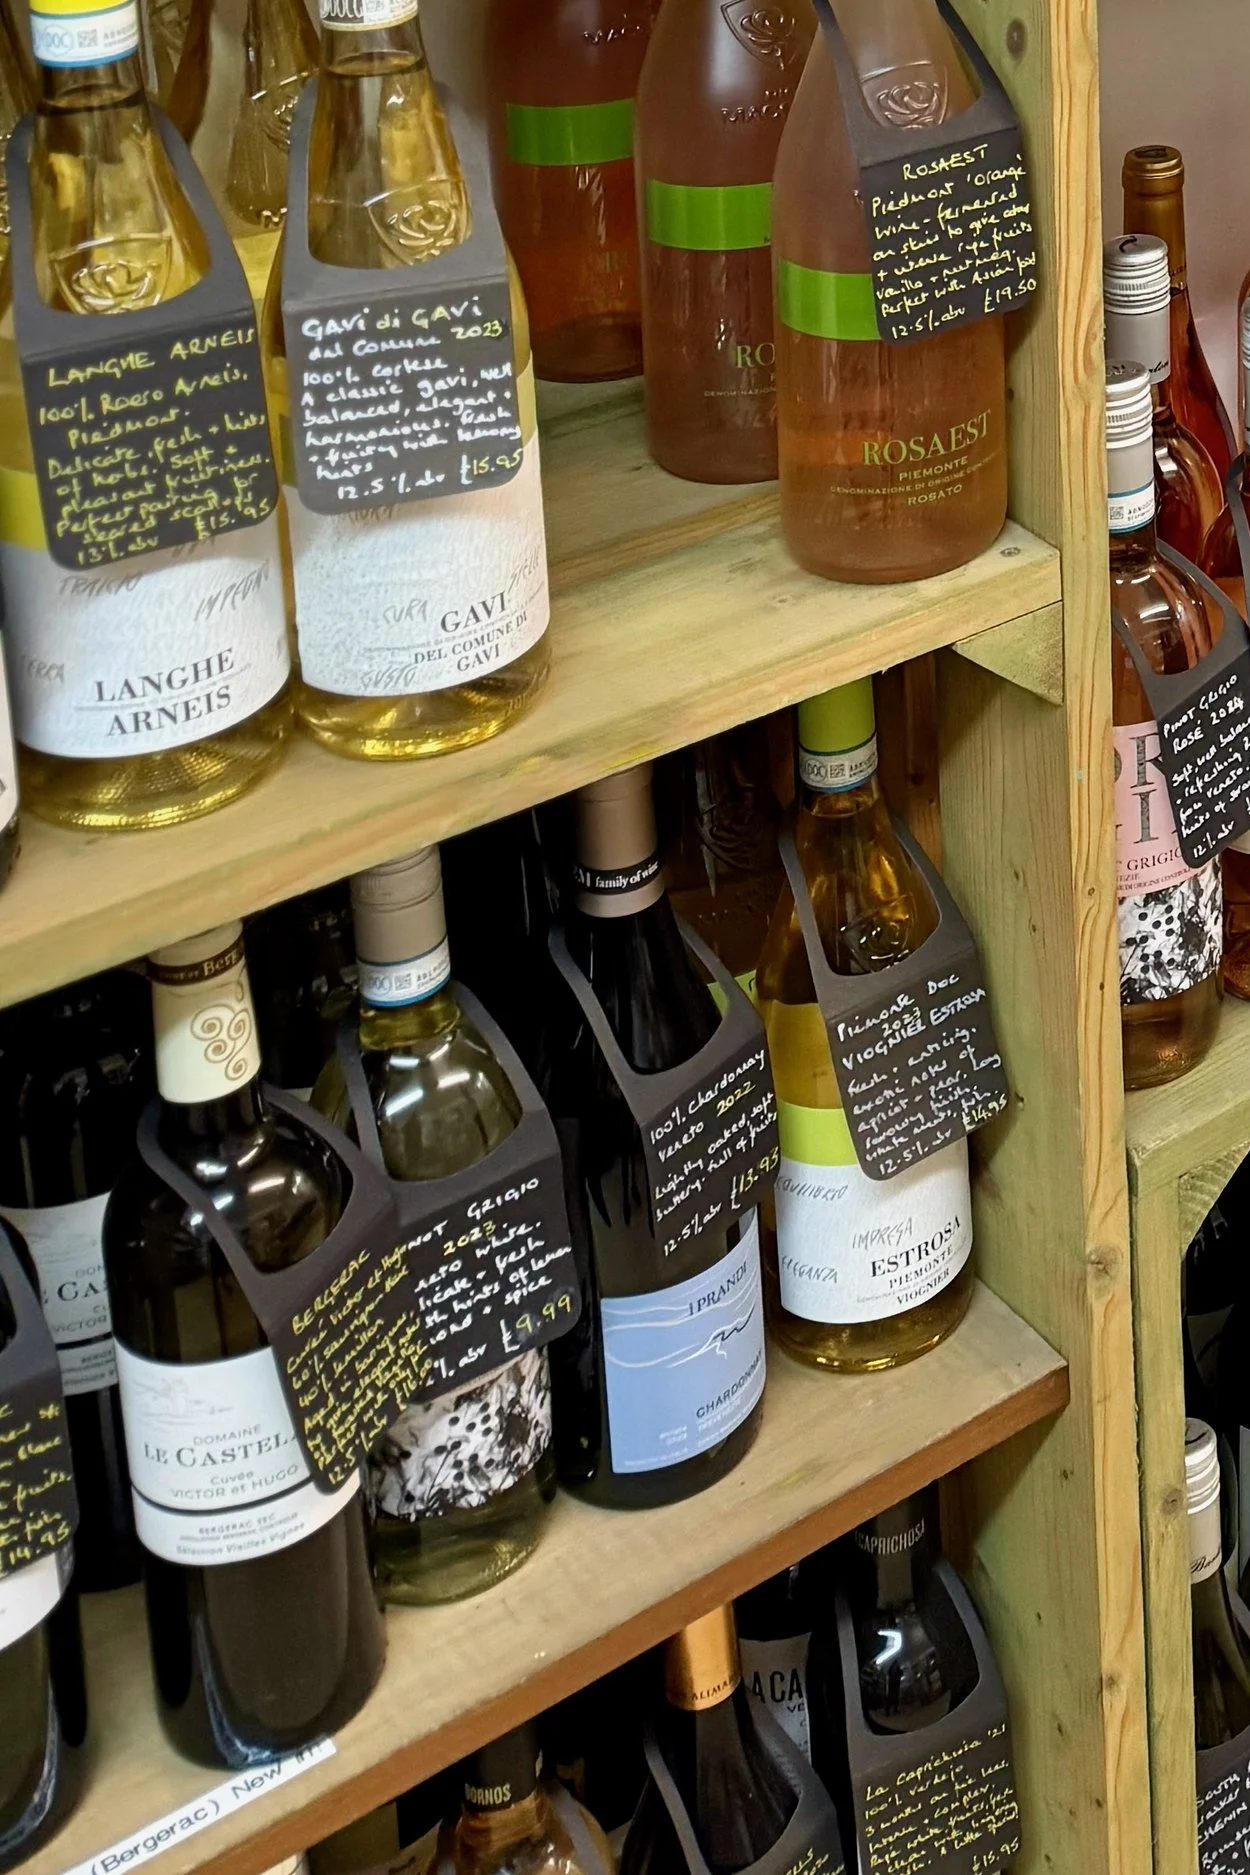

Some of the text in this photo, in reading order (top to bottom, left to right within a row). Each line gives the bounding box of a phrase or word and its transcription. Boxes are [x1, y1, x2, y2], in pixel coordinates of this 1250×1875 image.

[903, 144, 988, 180] ROSAEST
[985, 278, 1036, 313] £19.50
[376, 309, 400, 329] di
[451, 320, 503, 339] 2023
[170, 329, 255, 360] ARNEIS
[302, 392, 314, 406] A
[326, 379, 403, 402] classic
[862, 410, 991, 466] ROSAEST
[460, 448, 523, 485] £15.95
[899, 456, 968, 481] PIEMONTE
[908, 484, 962, 506] ROSATO
[439, 590, 507, 634] GAVI
[413, 611, 529, 666] DEL COMUNE DI
[93, 647, 237, 704] LANGHE
[455, 646, 501, 673] GAVI
[105, 686, 233, 739] ARNEIS
[596, 869, 641, 888] family of
[716, 1080, 756, 1118] 2022
[443, 1220, 497, 1257] 2023
[870, 1215, 961, 1278] ESTROSA
[889, 1245, 953, 1289] PIEMONTE
[697, 1261, 748, 1312] PRANDI
[897, 1267, 950, 1305] VIOGNIER
[500, 1294, 572, 1353] £9.99
[696, 1348, 762, 1419] CHARDONNAY
[193, 1424, 262, 1446] DOMAINE
[144, 1443, 168, 1465] LE
[170, 1489, 225, 1499] VICTOR
[252, 1464, 298, 1489] HUGO
[231, 1761, 283, 1801] New
